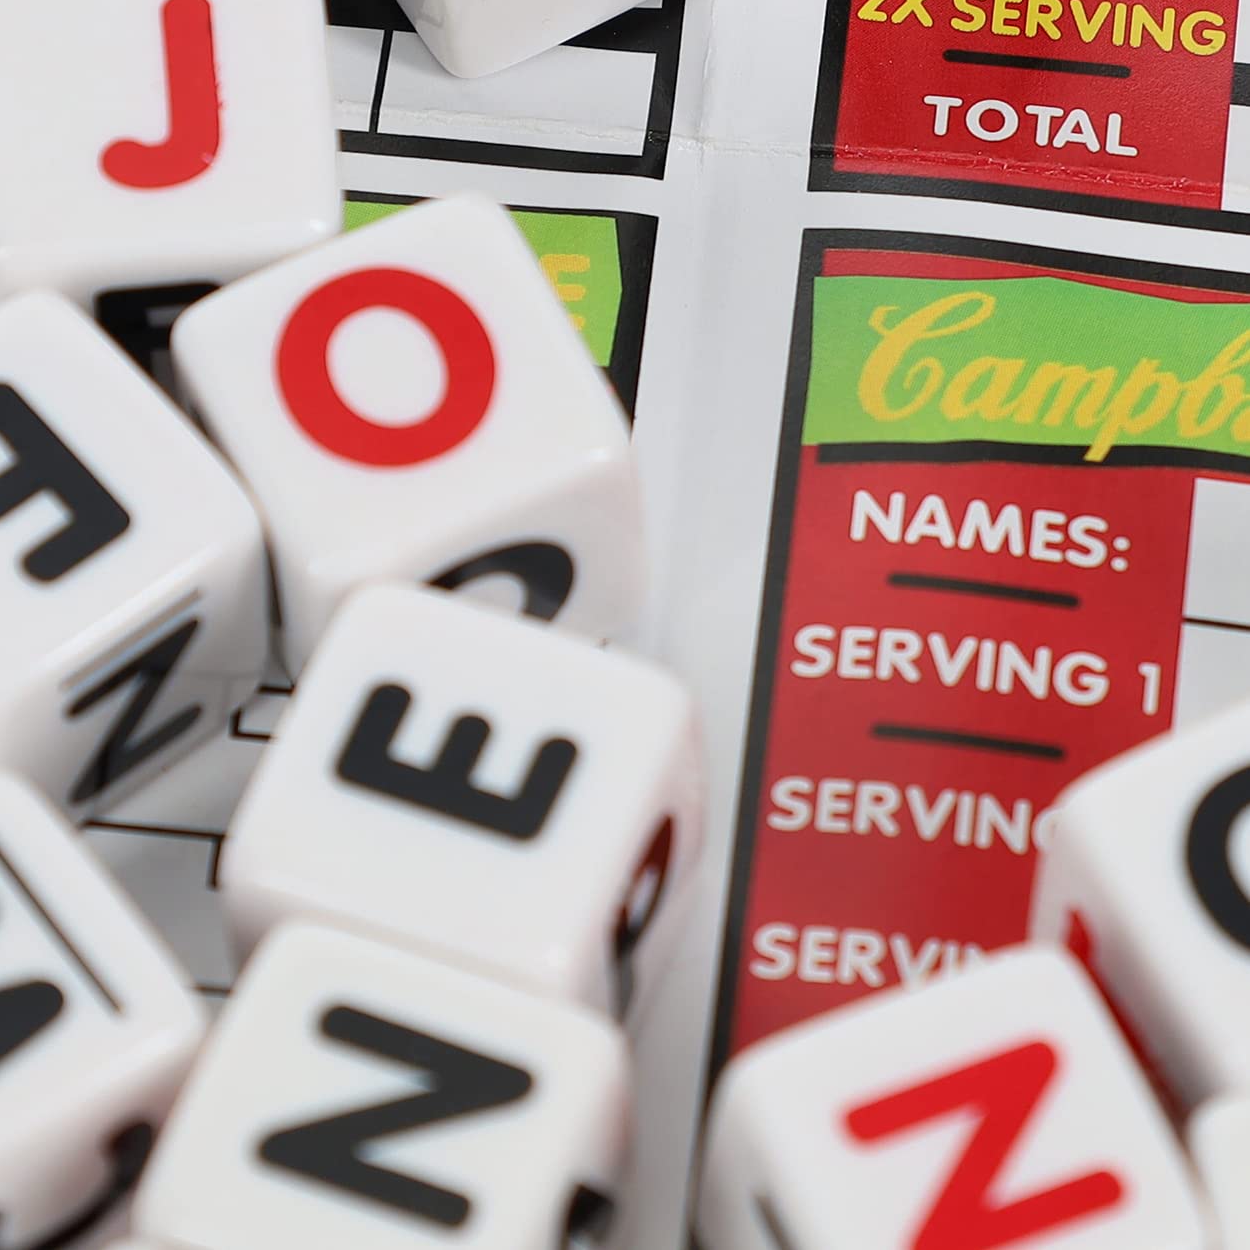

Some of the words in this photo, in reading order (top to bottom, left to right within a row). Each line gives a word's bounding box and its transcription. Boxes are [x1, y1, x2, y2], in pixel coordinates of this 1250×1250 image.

[923, 95, 1138, 158] TOTAL
[275, 265, 497, 469] O
[856, 291, 1250, 462] Campb
[849, 490, 1131, 572] NAMES:
[791, 624, 1110, 706] SERVING
[1138, 661, 1162, 716] 1
[337, 682, 578, 841] E
[751, 923, 992, 996] SERV
